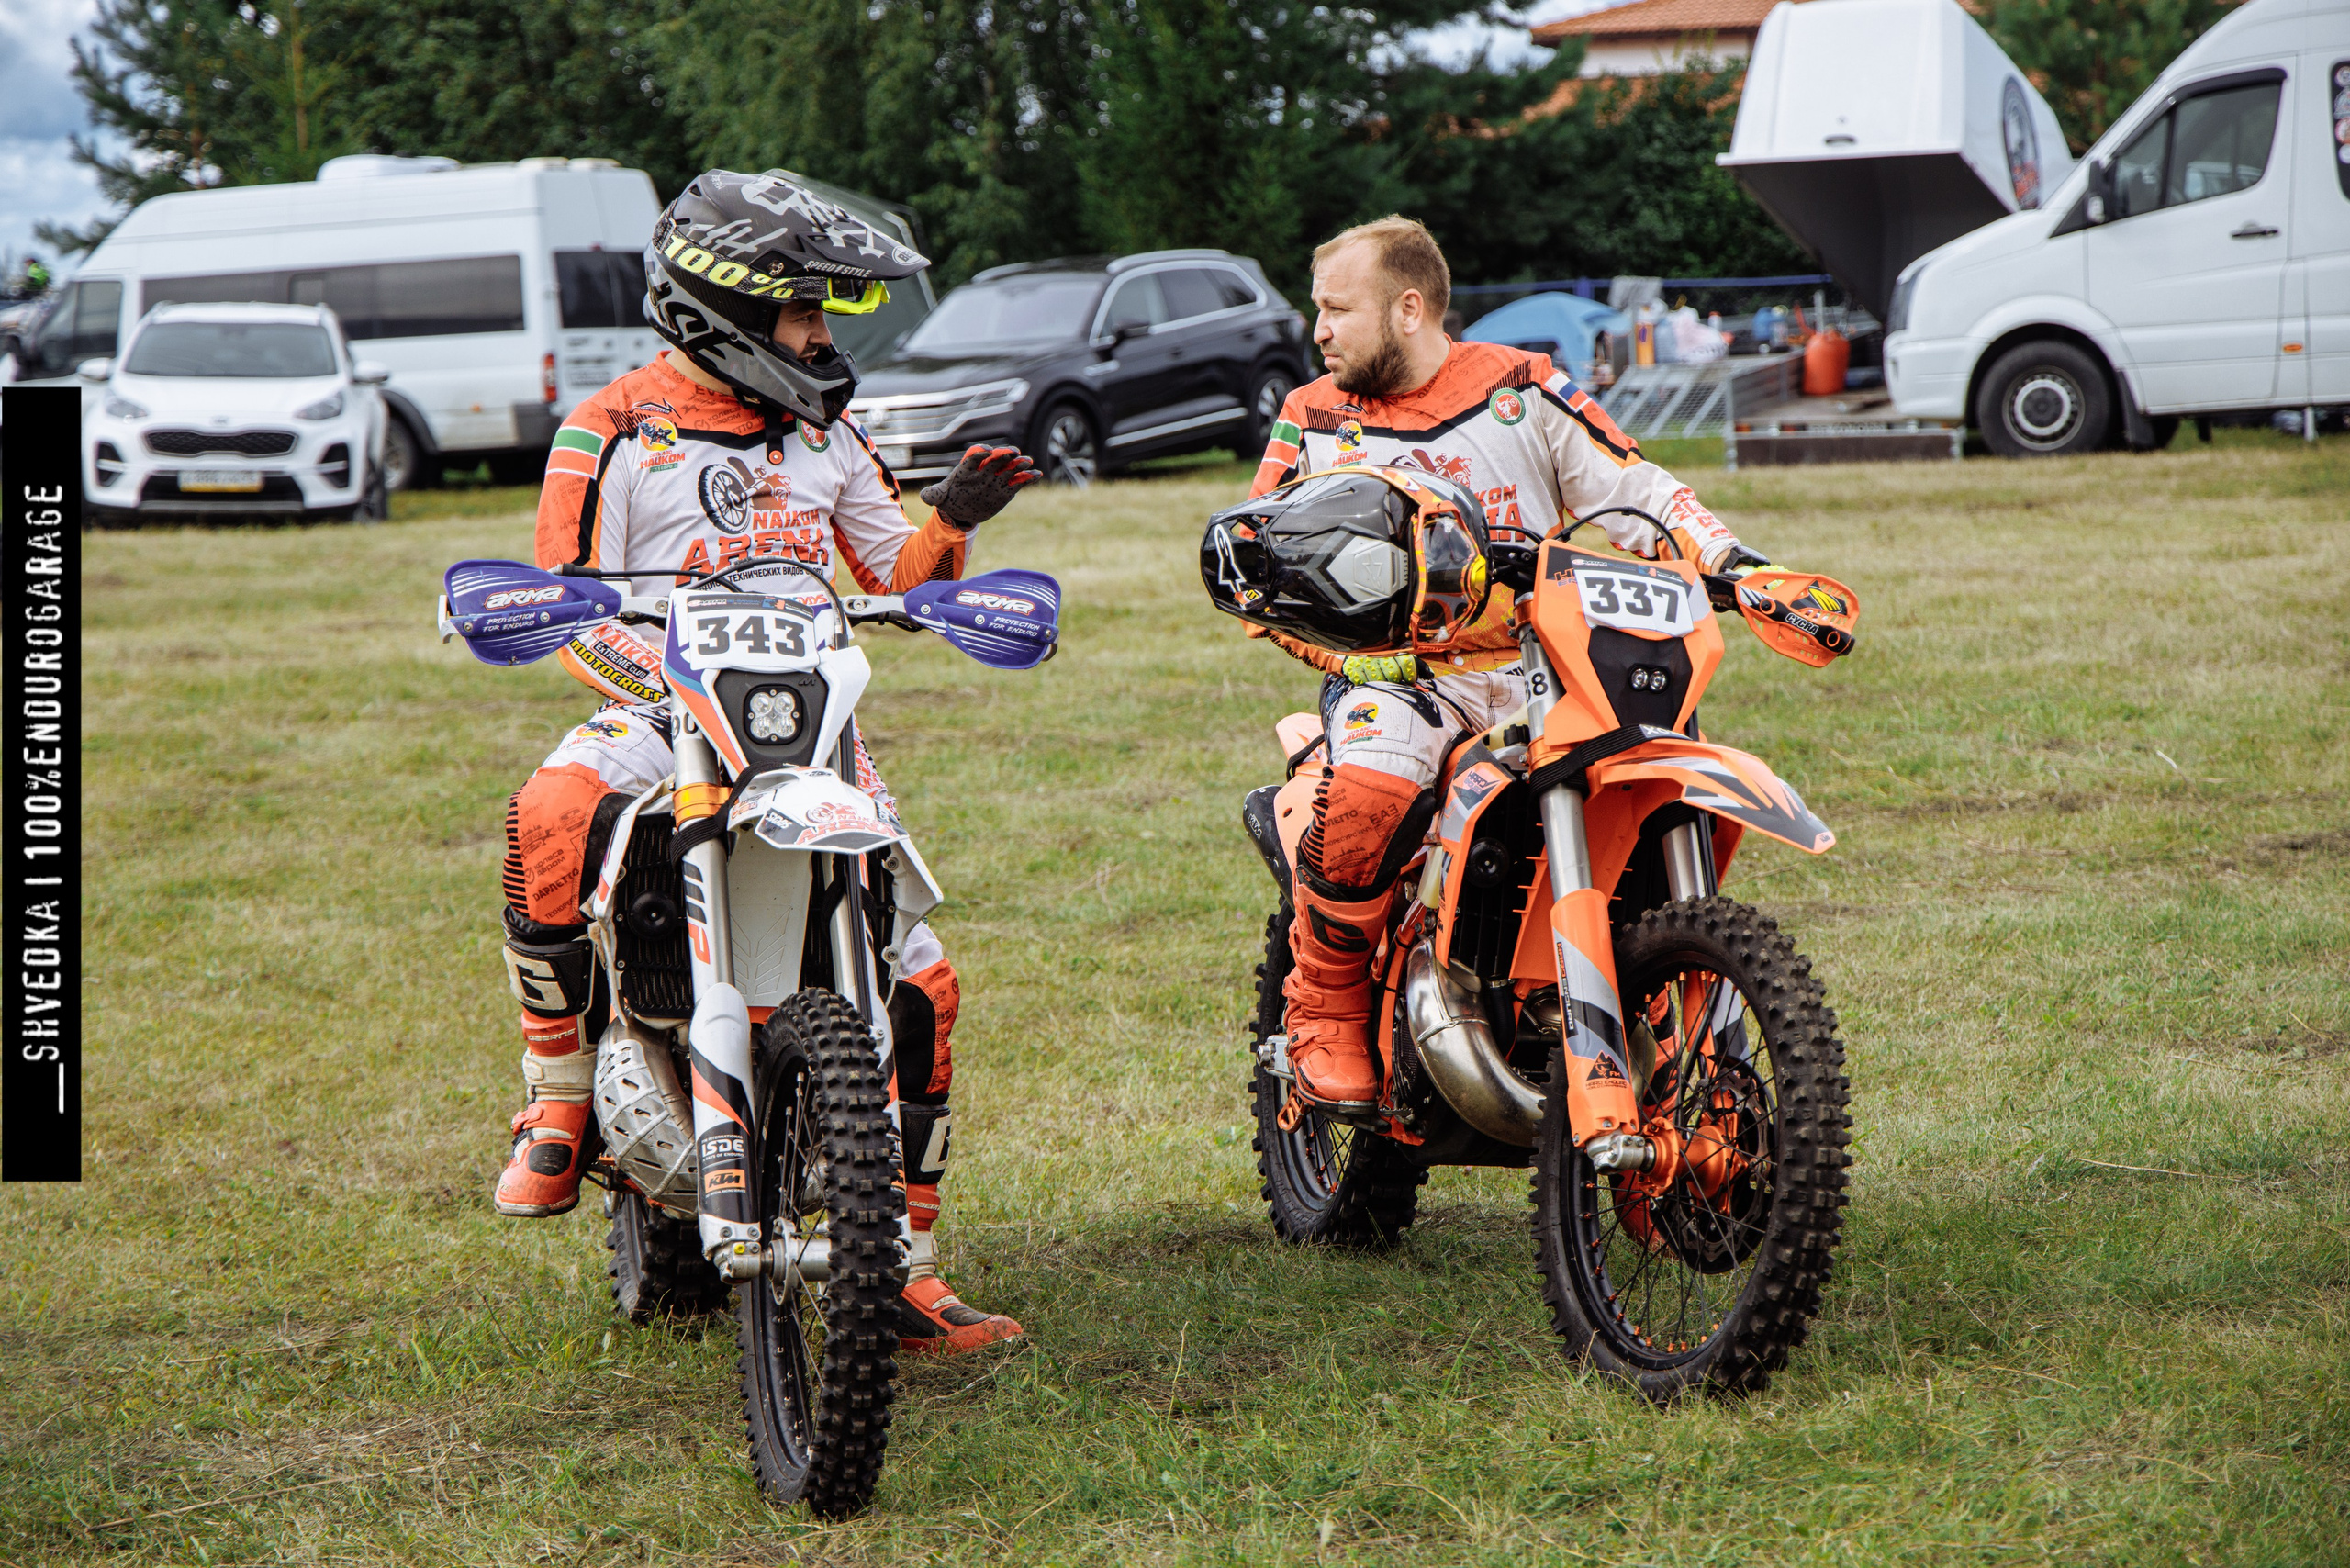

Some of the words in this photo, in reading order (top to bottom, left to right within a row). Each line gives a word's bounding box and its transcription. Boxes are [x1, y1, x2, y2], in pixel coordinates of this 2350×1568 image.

[663, 234, 795, 299] 100%
[805, 260, 836, 273] SPEED
[841, 264, 872, 278] STYLE
[752, 508, 821, 531] NAIKOM
[675, 527, 829, 589] ARENA
[1583, 577, 1679, 624] 337
[483, 623, 500, 633] FOR
[503, 620, 535, 631] ENDURO
[487, 611, 536, 625] PROTECTION
[993, 616, 1041, 631] PROTECTION
[1785, 612, 1819, 635] CYCRA
[697, 615, 806, 658] 343
[988, 622, 1005, 631] FOR
[1006, 625, 1038, 637] ENDURO
[569, 637, 666, 704] MOTOCROSS
[701, 1138, 744, 1158] ISDE
[709, 1172, 741, 1188] KTM
